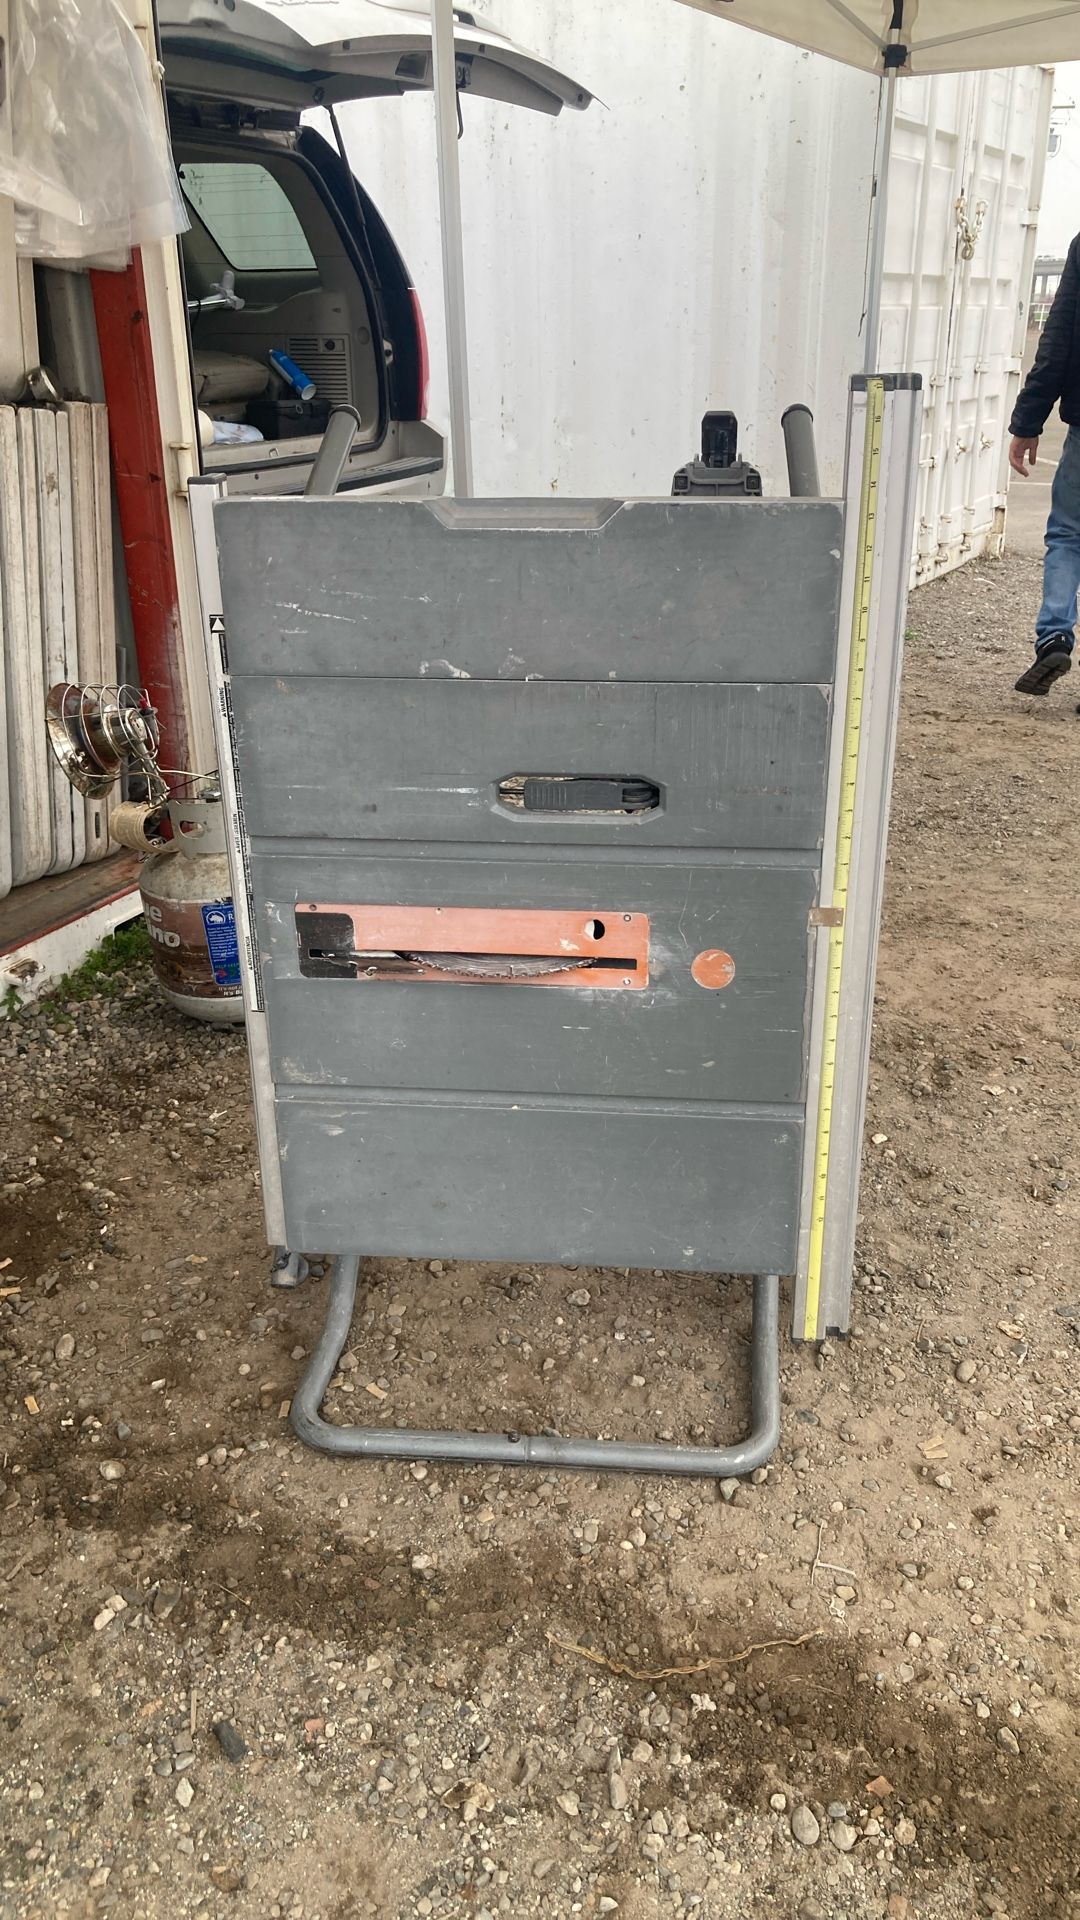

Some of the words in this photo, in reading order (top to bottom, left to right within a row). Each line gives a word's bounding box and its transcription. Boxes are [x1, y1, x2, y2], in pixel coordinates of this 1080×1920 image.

[875, 415, 882, 423] 16
[872, 447, 880, 455] 15
[870, 480, 877, 488] 14
[868, 512, 875, 520] 13
[866, 544, 873, 552] 12
